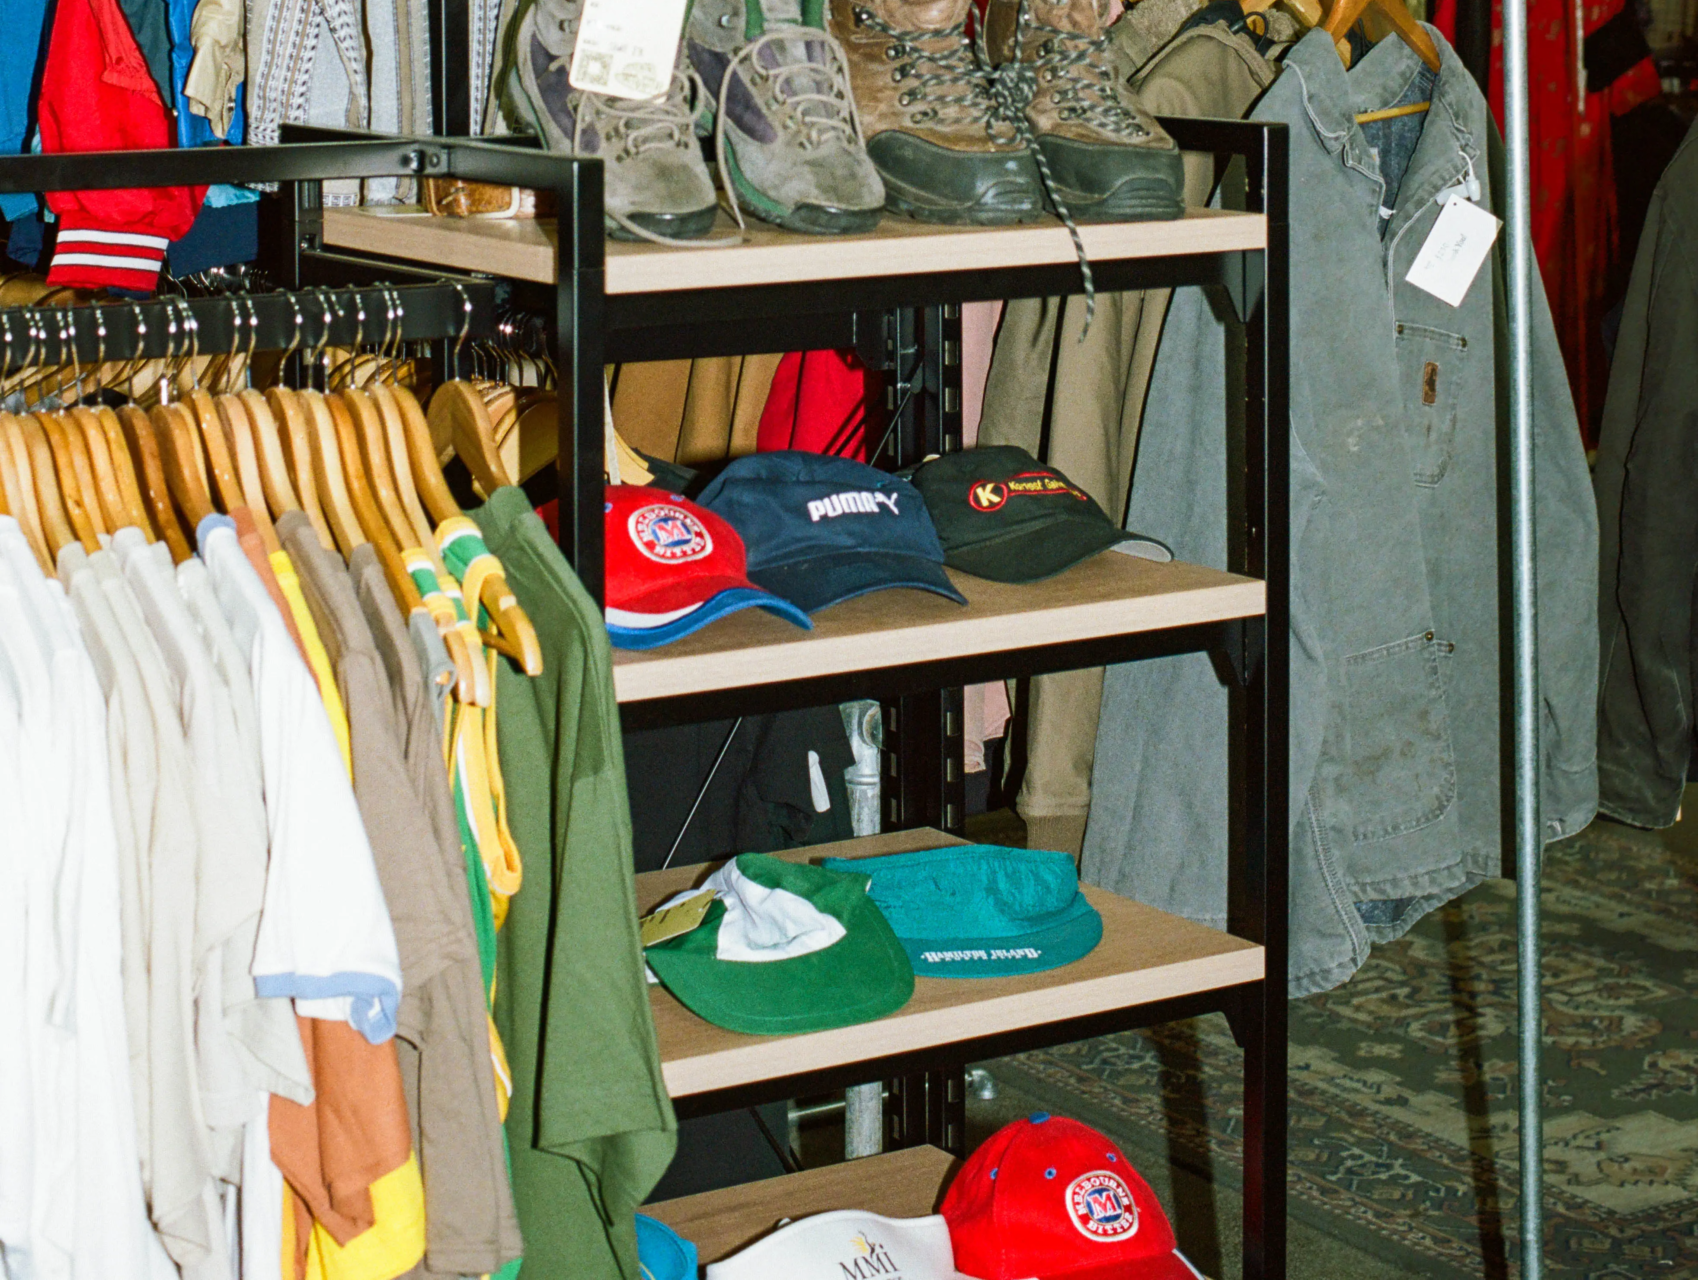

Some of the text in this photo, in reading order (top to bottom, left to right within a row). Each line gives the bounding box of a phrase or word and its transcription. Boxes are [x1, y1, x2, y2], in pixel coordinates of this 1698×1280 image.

[807, 491, 880, 522] PUMA
[975, 482, 1002, 507] K
[637, 508, 701, 543] MELBOURNE
[653, 520, 692, 547] M
[653, 537, 706, 558] BITTER
[1073, 1176, 1130, 1216] MELBOURNE
[1086, 1191, 1122, 1220] M
[1087, 1211, 1134, 1235] BITTER
